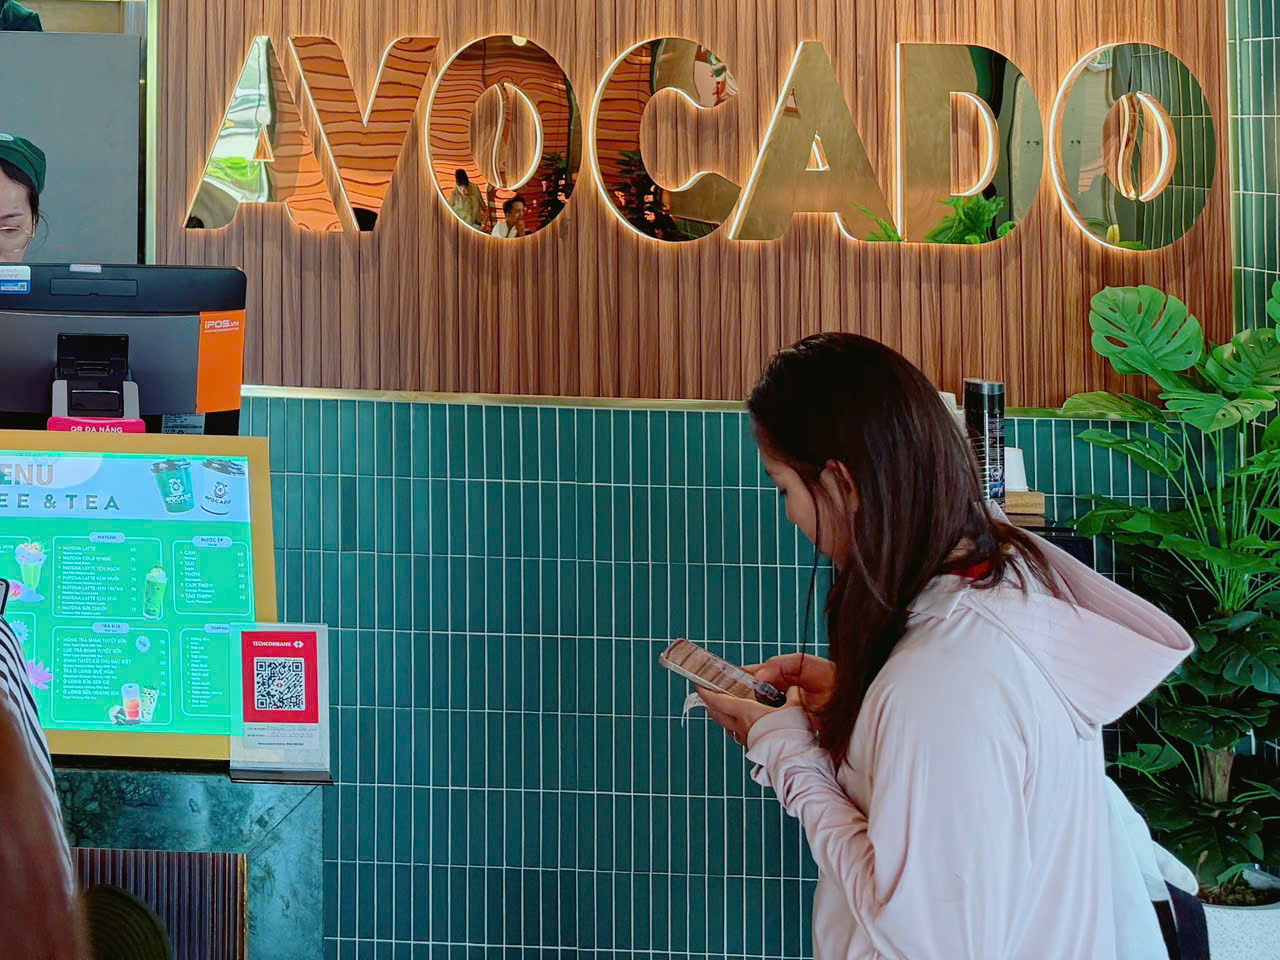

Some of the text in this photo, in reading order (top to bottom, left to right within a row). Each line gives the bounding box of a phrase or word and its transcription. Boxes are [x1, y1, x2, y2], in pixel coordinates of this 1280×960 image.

[181, 33, 1216, 251] AVOCADO
[43, 493, 57, 509] &
[65, 494, 120, 511] TEA
